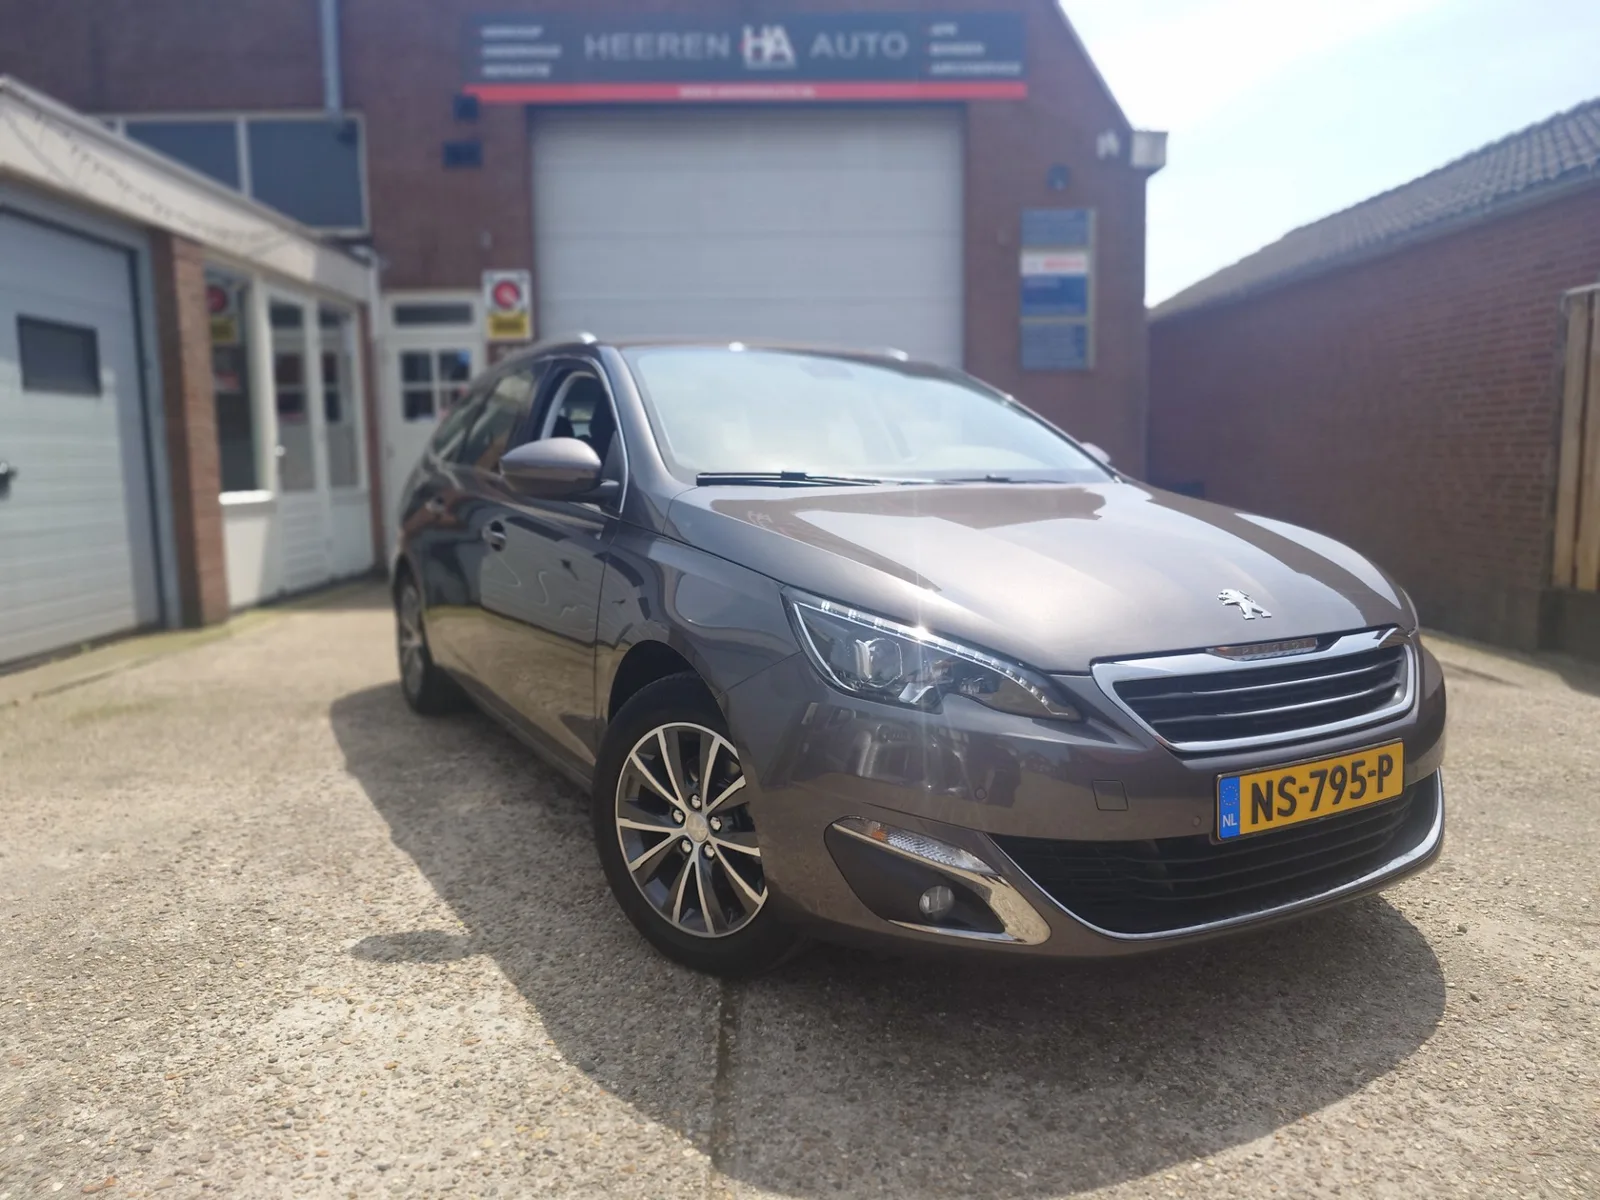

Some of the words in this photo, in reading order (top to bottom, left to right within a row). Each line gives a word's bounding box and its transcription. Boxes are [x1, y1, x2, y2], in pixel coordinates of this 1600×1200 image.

[583, 31, 731, 62] HEEREN
[742, 24, 797, 69] HA
[809, 31, 909, 60] AUTO
[1250, 753, 1394, 825] NS-795-P
[1222, 814, 1238, 828] NL
